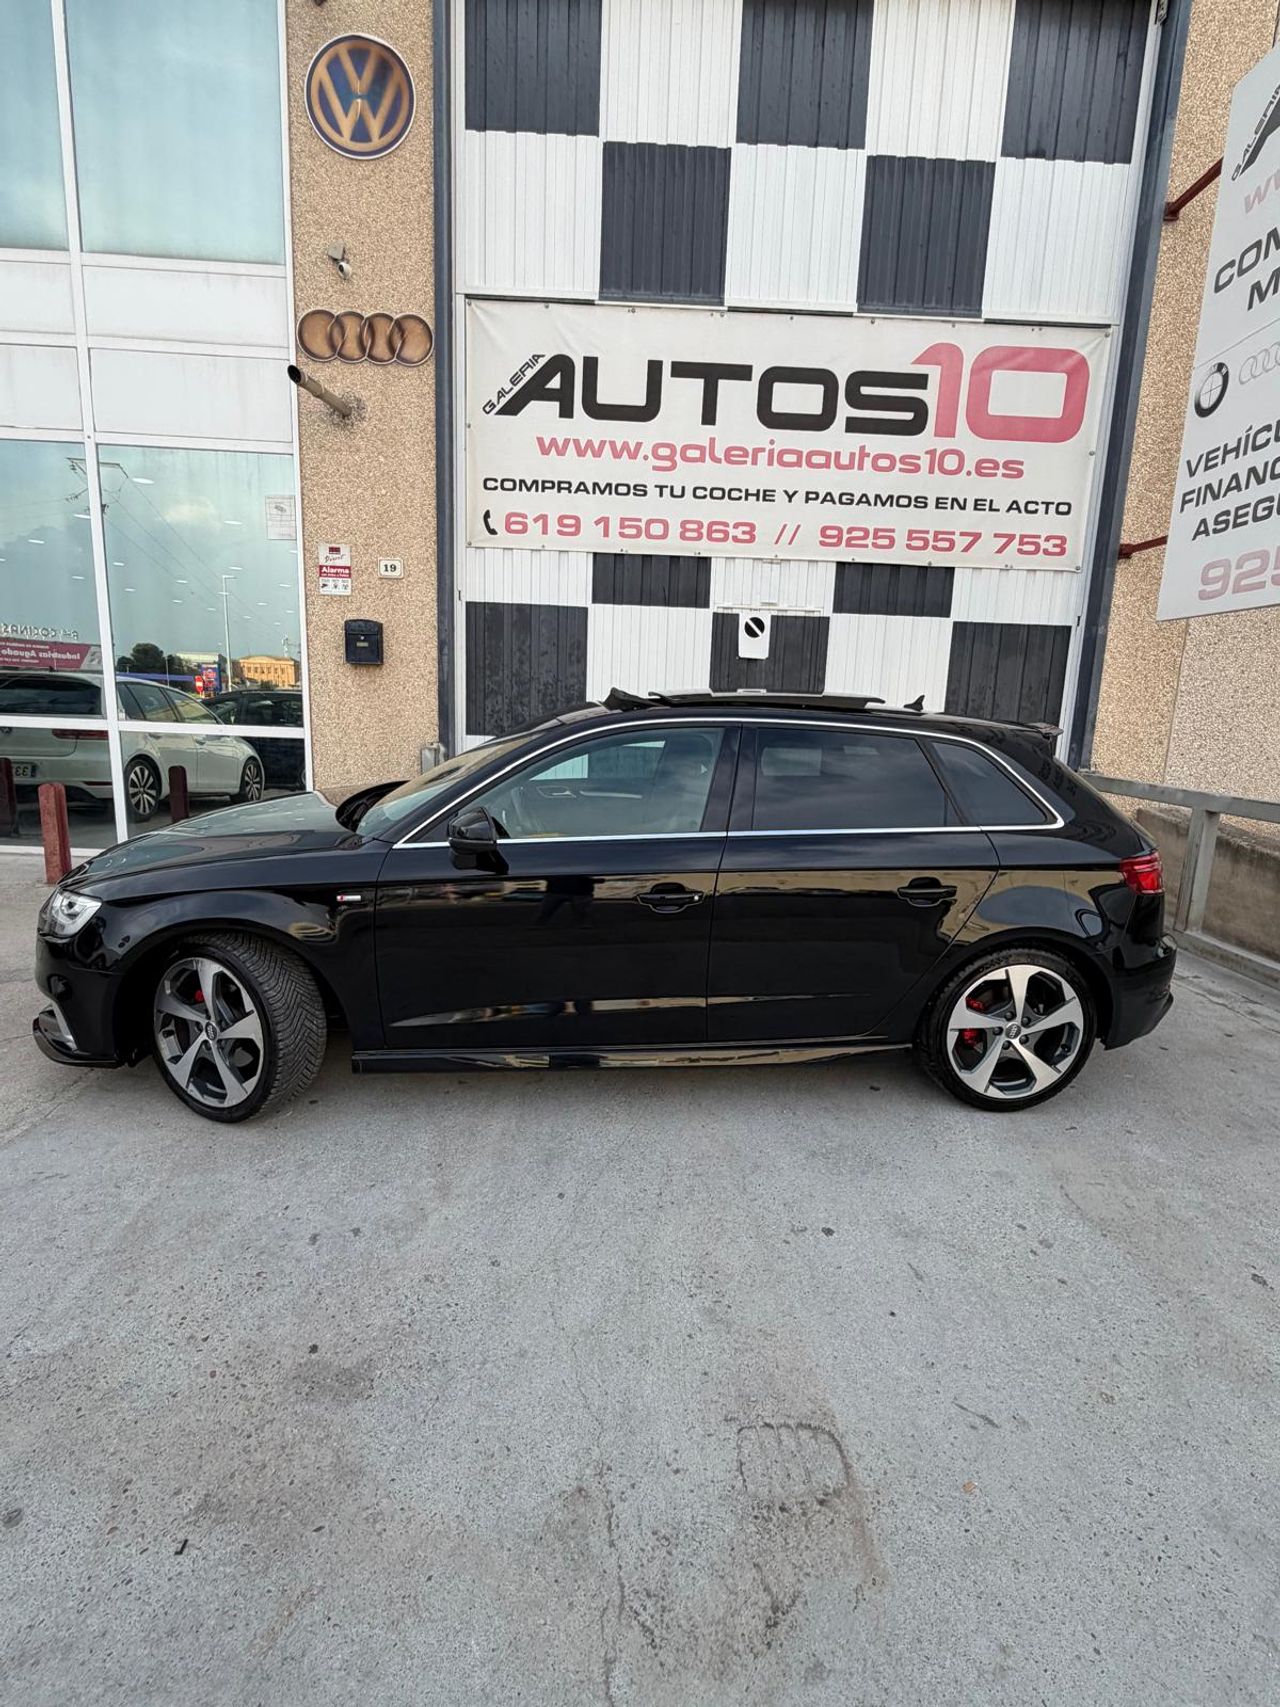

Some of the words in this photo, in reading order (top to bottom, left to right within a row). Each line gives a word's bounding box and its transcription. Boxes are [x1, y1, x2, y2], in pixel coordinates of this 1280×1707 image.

[482, 354, 546, 415] GALERIA
[536, 436, 1025, 479] www.galeriaautos10.es
[1186, 419, 1280, 478] VEHÍC
[482, 477, 649, 497] COMPRAMOS
[654, 484, 686, 499] TU
[692, 486, 777, 502] COCHE
[783, 489, 799, 503] Y
[804, 490, 929, 509] PAGAMOS
[934, 496, 968, 512] EN
[973, 498, 1000, 512] EL
[1005, 499, 1073, 516] ACTO
[1192, 493, 1280, 541] ASEG
[503, 511, 582, 537] 619
[593, 516, 670, 541] 150
[679, 519, 757, 544] 863
[818, 524, 896, 550] 925
[905, 528, 983, 554] 557
[992, 532, 1068, 557] 753
[321, 566, 350, 574] Alarma
[384, 563, 397, 573] 19
[1198, 546, 1280, 600] 92
